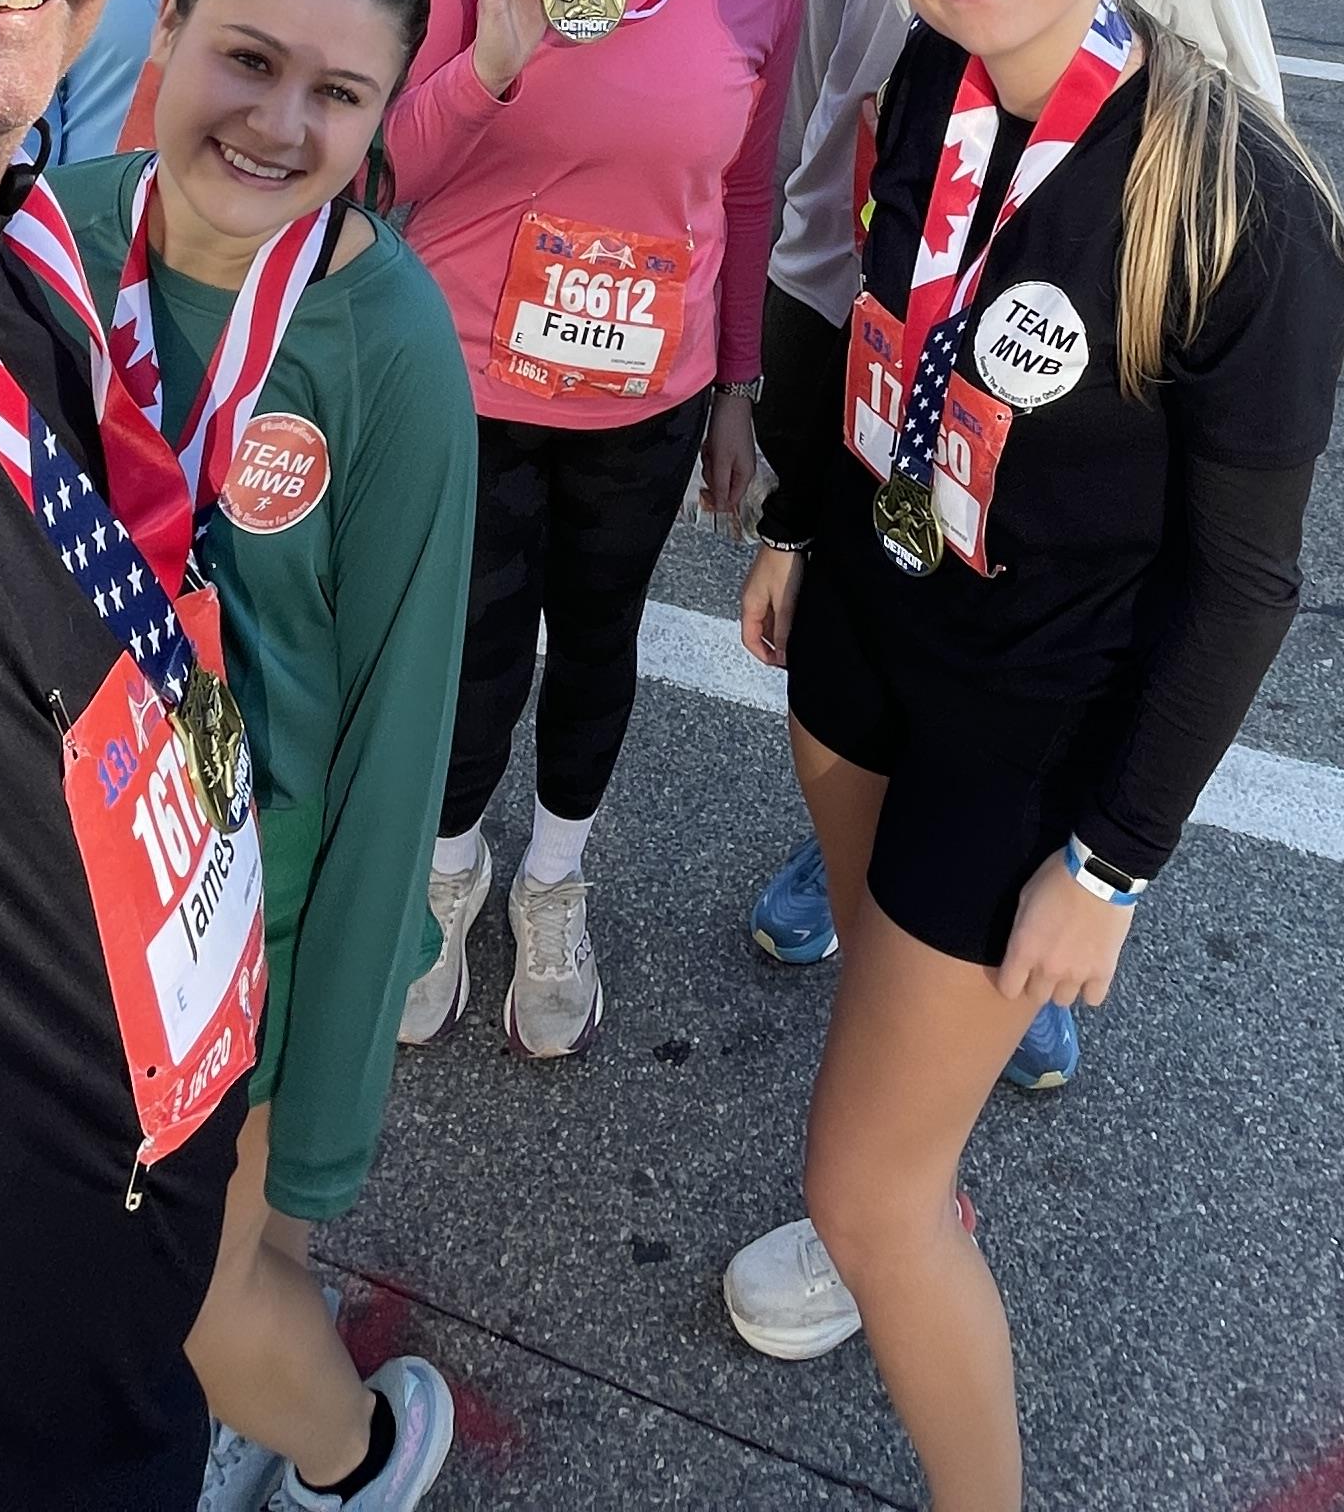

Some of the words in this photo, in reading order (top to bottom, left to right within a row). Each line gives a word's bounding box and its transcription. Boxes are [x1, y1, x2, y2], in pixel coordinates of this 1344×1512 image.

[560, 19, 609, 32] DETROIT
[543, 263, 657, 325] 16612
[515, 332, 523, 343] E
[542, 311, 626, 351] Faith
[1005, 299, 1080, 353] TEAM
[515, 358, 549, 385] 16612
[989, 334, 1063, 375] MWB
[998, 387, 1028, 404] Distance
[1042, 384, 1066, 401] Others
[859, 432, 865, 446] E
[241, 439, 316, 476] TEAM
[237, 465, 306, 498] MWB
[179, 834, 235, 966] James
[176, 986, 188, 1013] E
[184, 1026, 233, 1110] 16720
